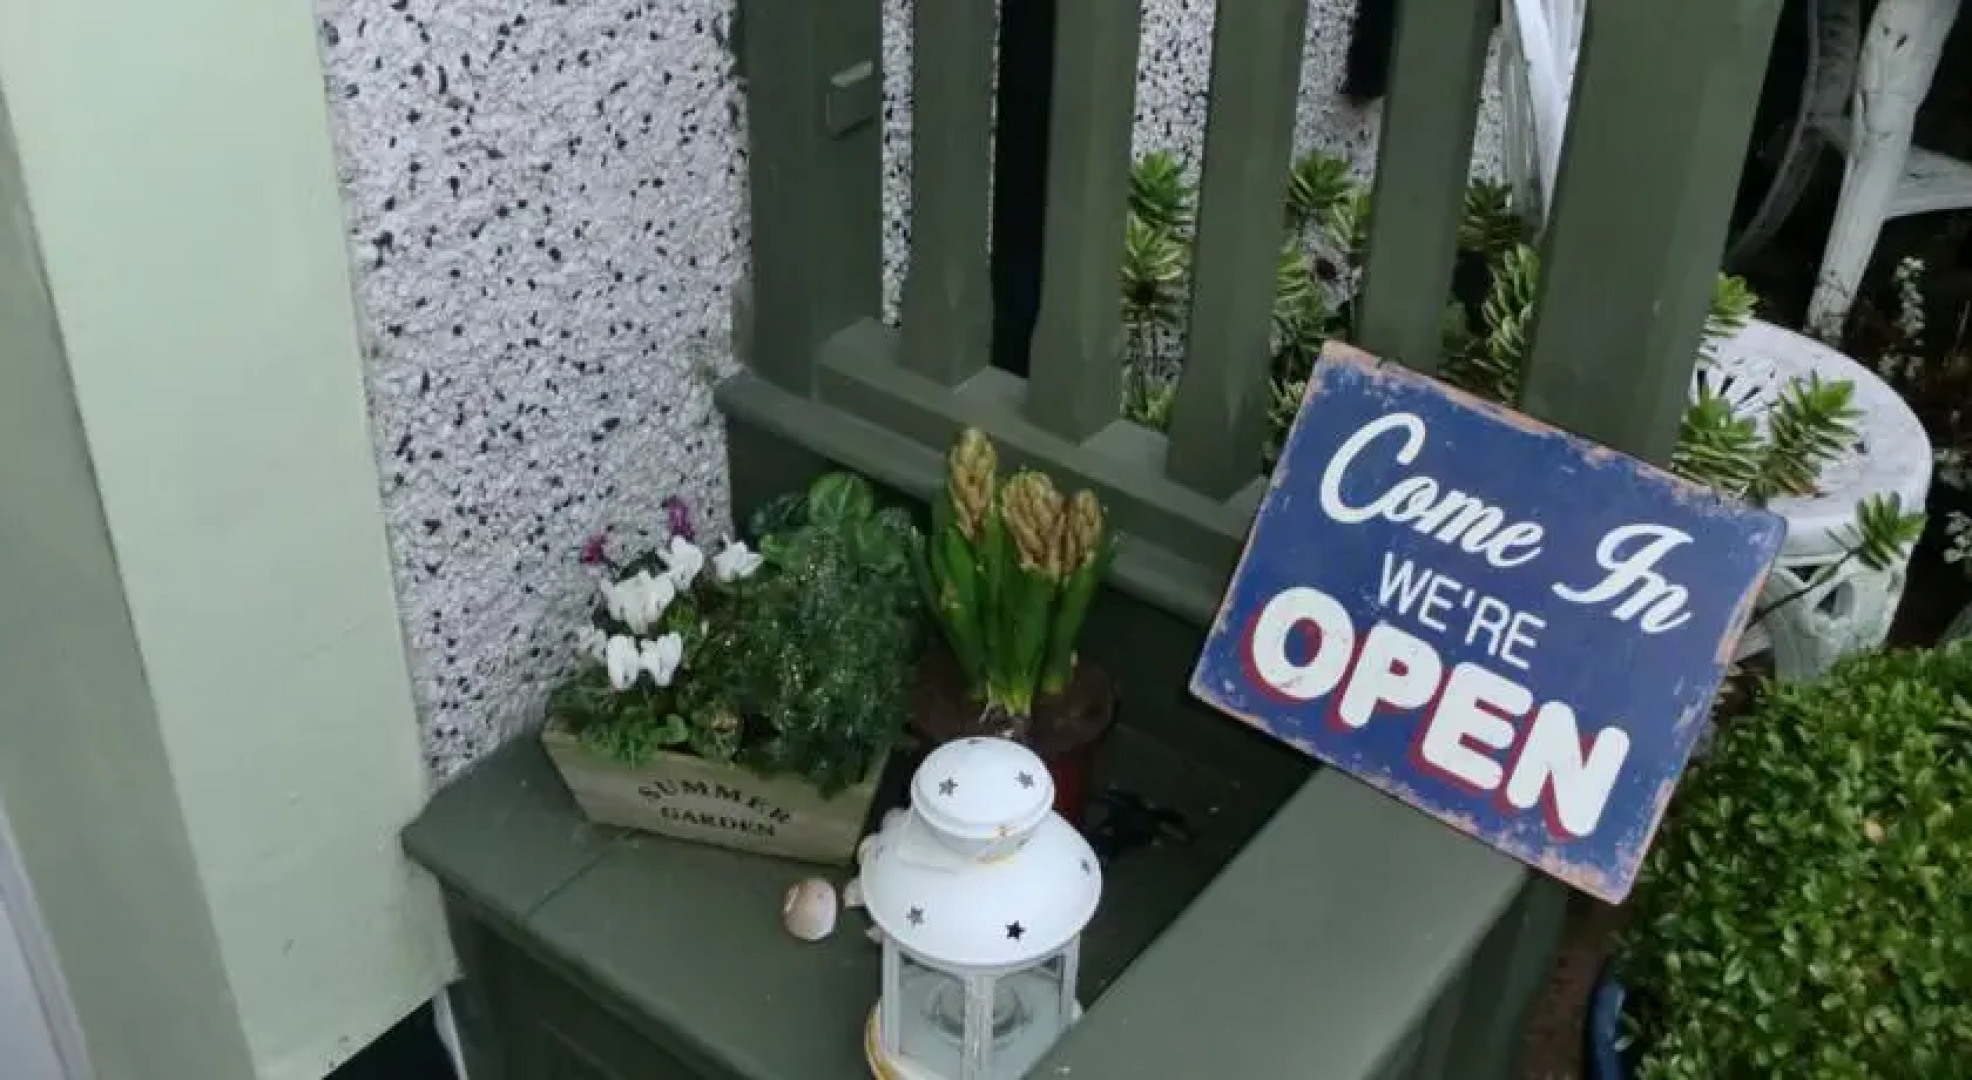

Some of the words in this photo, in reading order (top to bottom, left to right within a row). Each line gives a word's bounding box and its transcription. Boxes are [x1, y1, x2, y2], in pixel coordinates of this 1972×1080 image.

[1319, 412, 1544, 567] Come
[1551, 522, 1695, 633] In
[1378, 551, 1547, 670] WE'RE
[1244, 586, 1631, 838] OPEN
[637, 778, 793, 824] SUMMER
[660, 806, 776, 838] GARDEN
